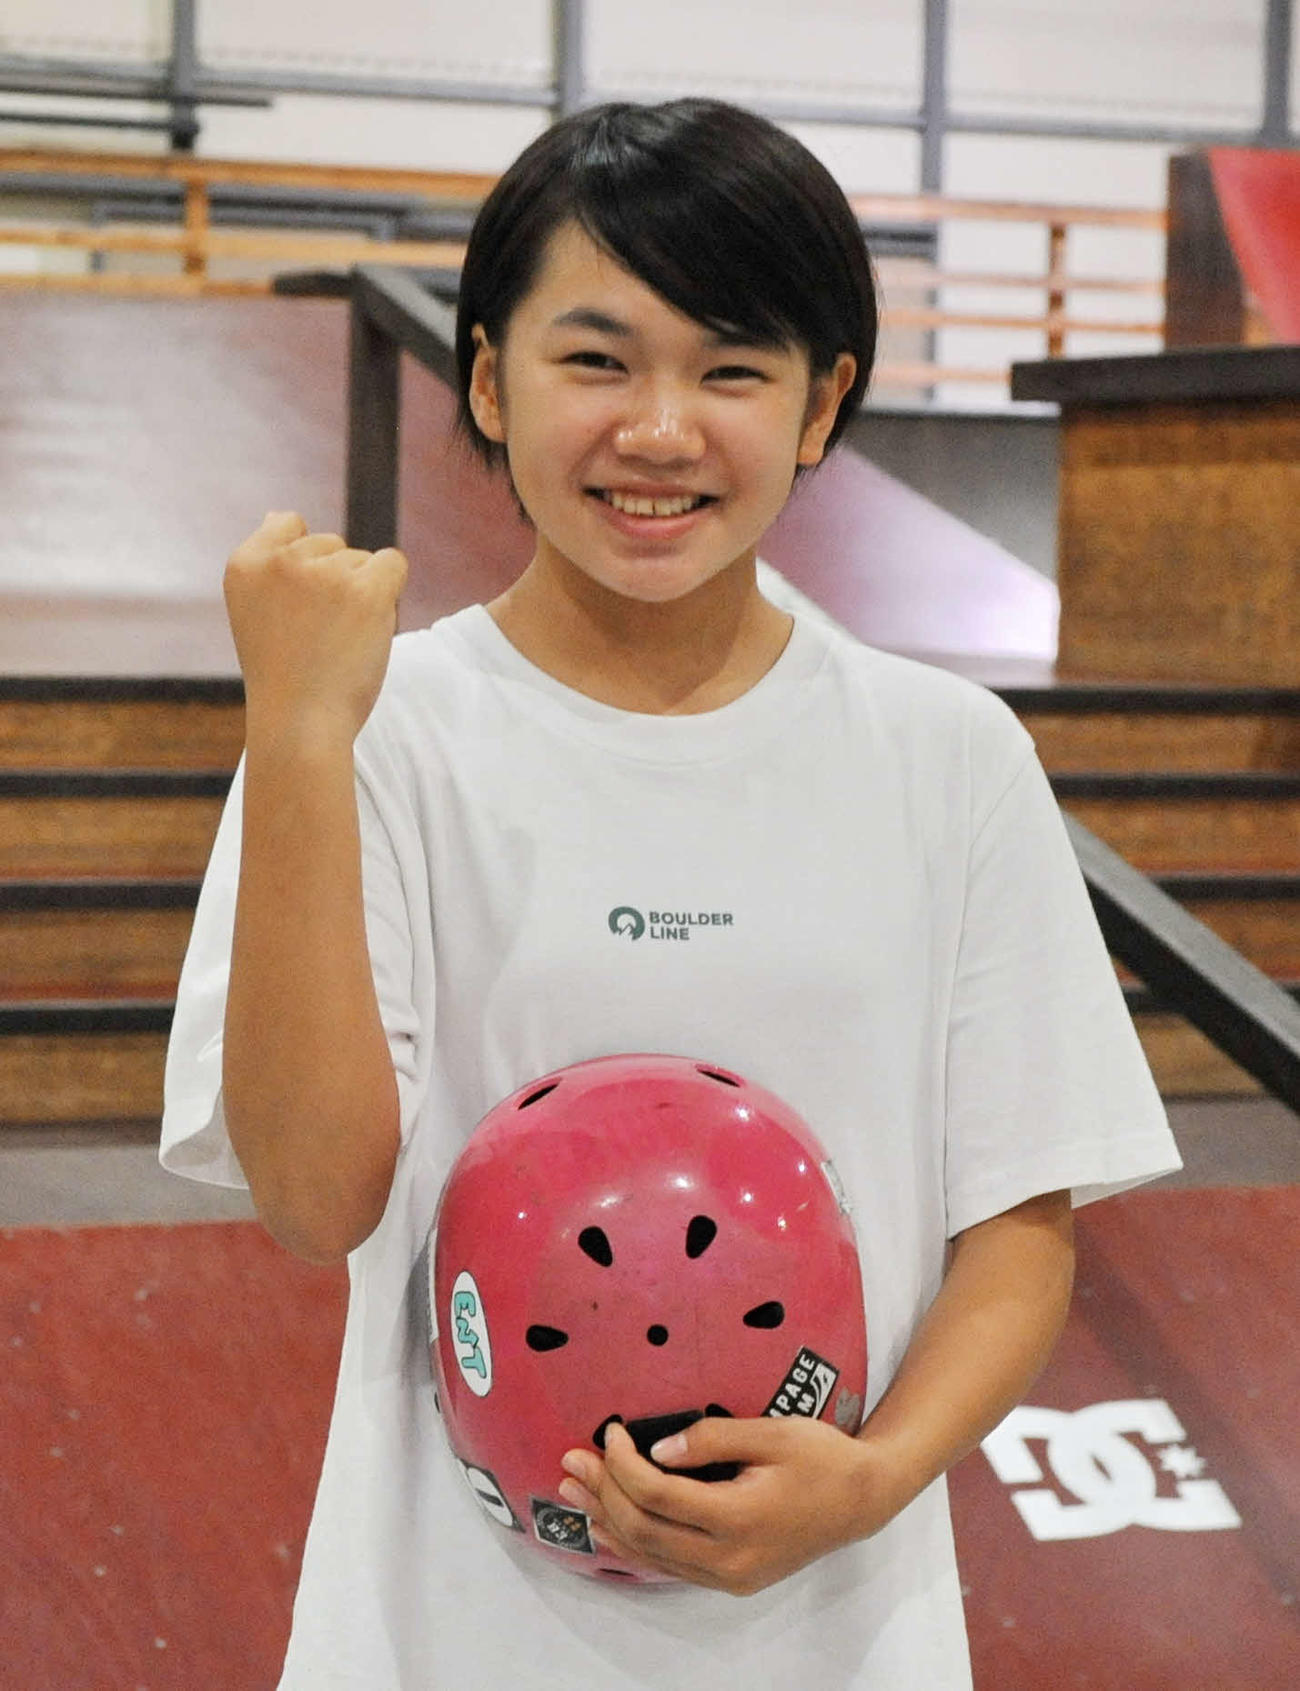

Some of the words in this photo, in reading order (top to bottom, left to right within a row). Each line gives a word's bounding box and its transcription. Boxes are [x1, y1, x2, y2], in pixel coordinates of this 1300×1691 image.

[649, 911, 734, 926] BOULDER
[650, 926, 690, 941] LINE
[980, 1398, 1242, 1541] DC
